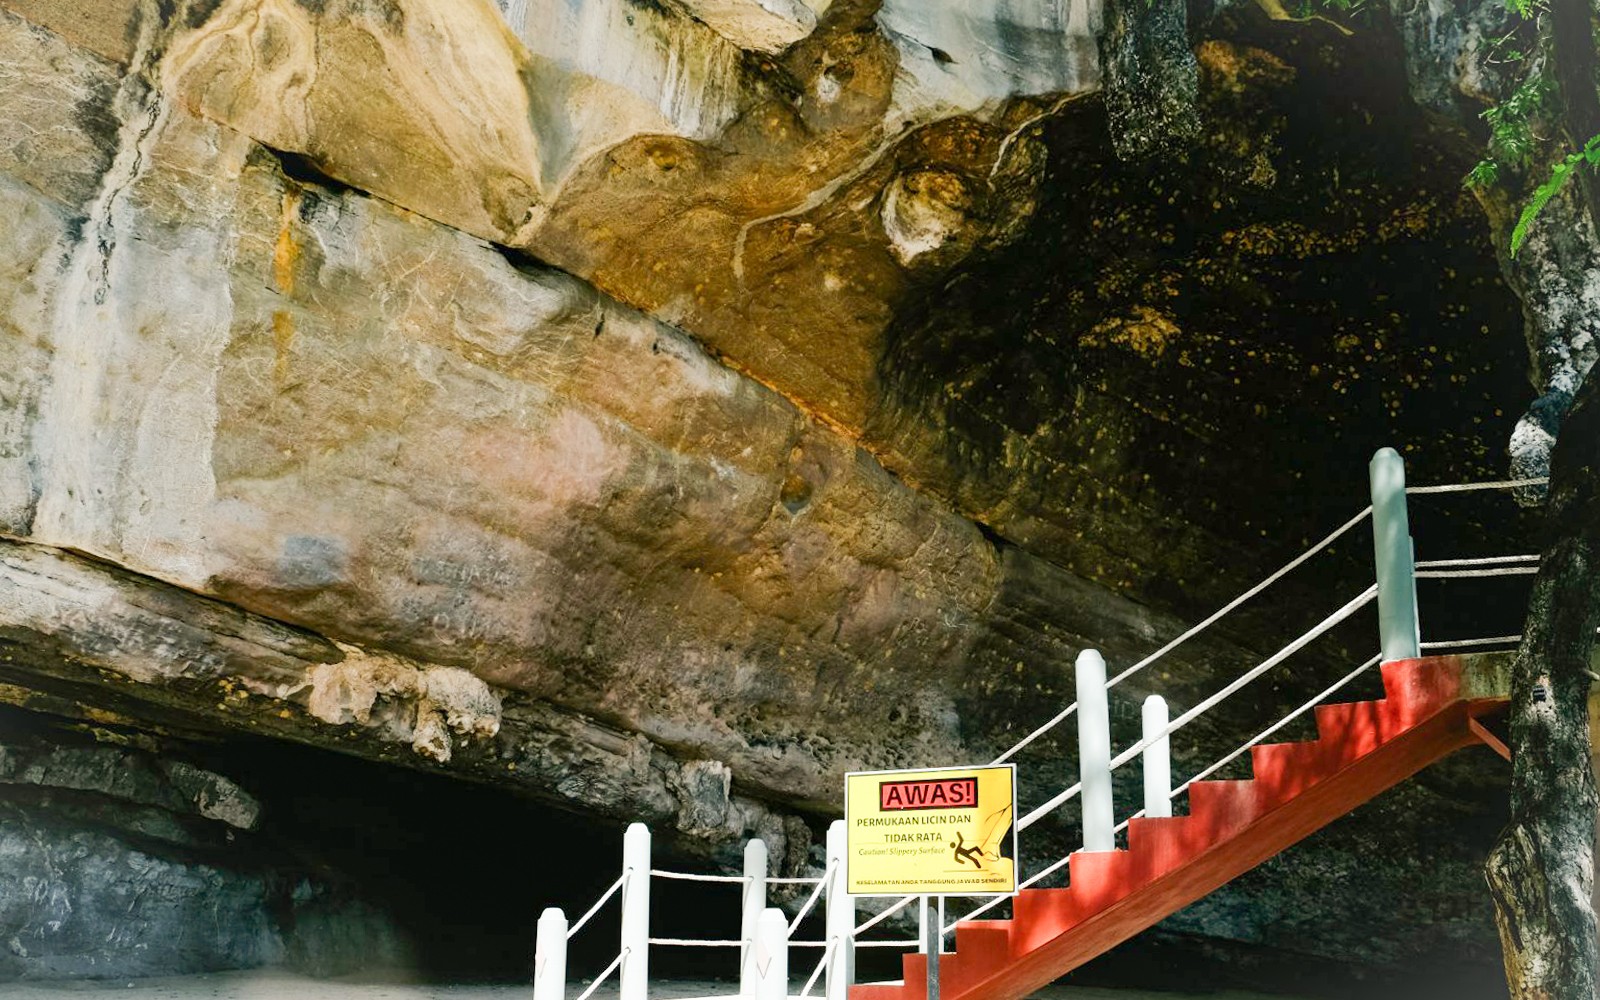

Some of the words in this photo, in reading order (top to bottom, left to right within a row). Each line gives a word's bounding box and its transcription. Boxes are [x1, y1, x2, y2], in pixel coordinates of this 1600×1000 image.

[885, 782, 971, 806] AWAS!
[856, 816, 920, 827] PERMUKAAN
[921, 815, 947, 825] LICIN
[948, 814, 971, 824] DAN
[884, 833, 915, 843] TIDAK
[916, 832, 943, 842] RATA
[858, 847, 889, 856] Caution!
[889, 846, 917, 857] Slippery
[918, 846, 946, 855] Surface
